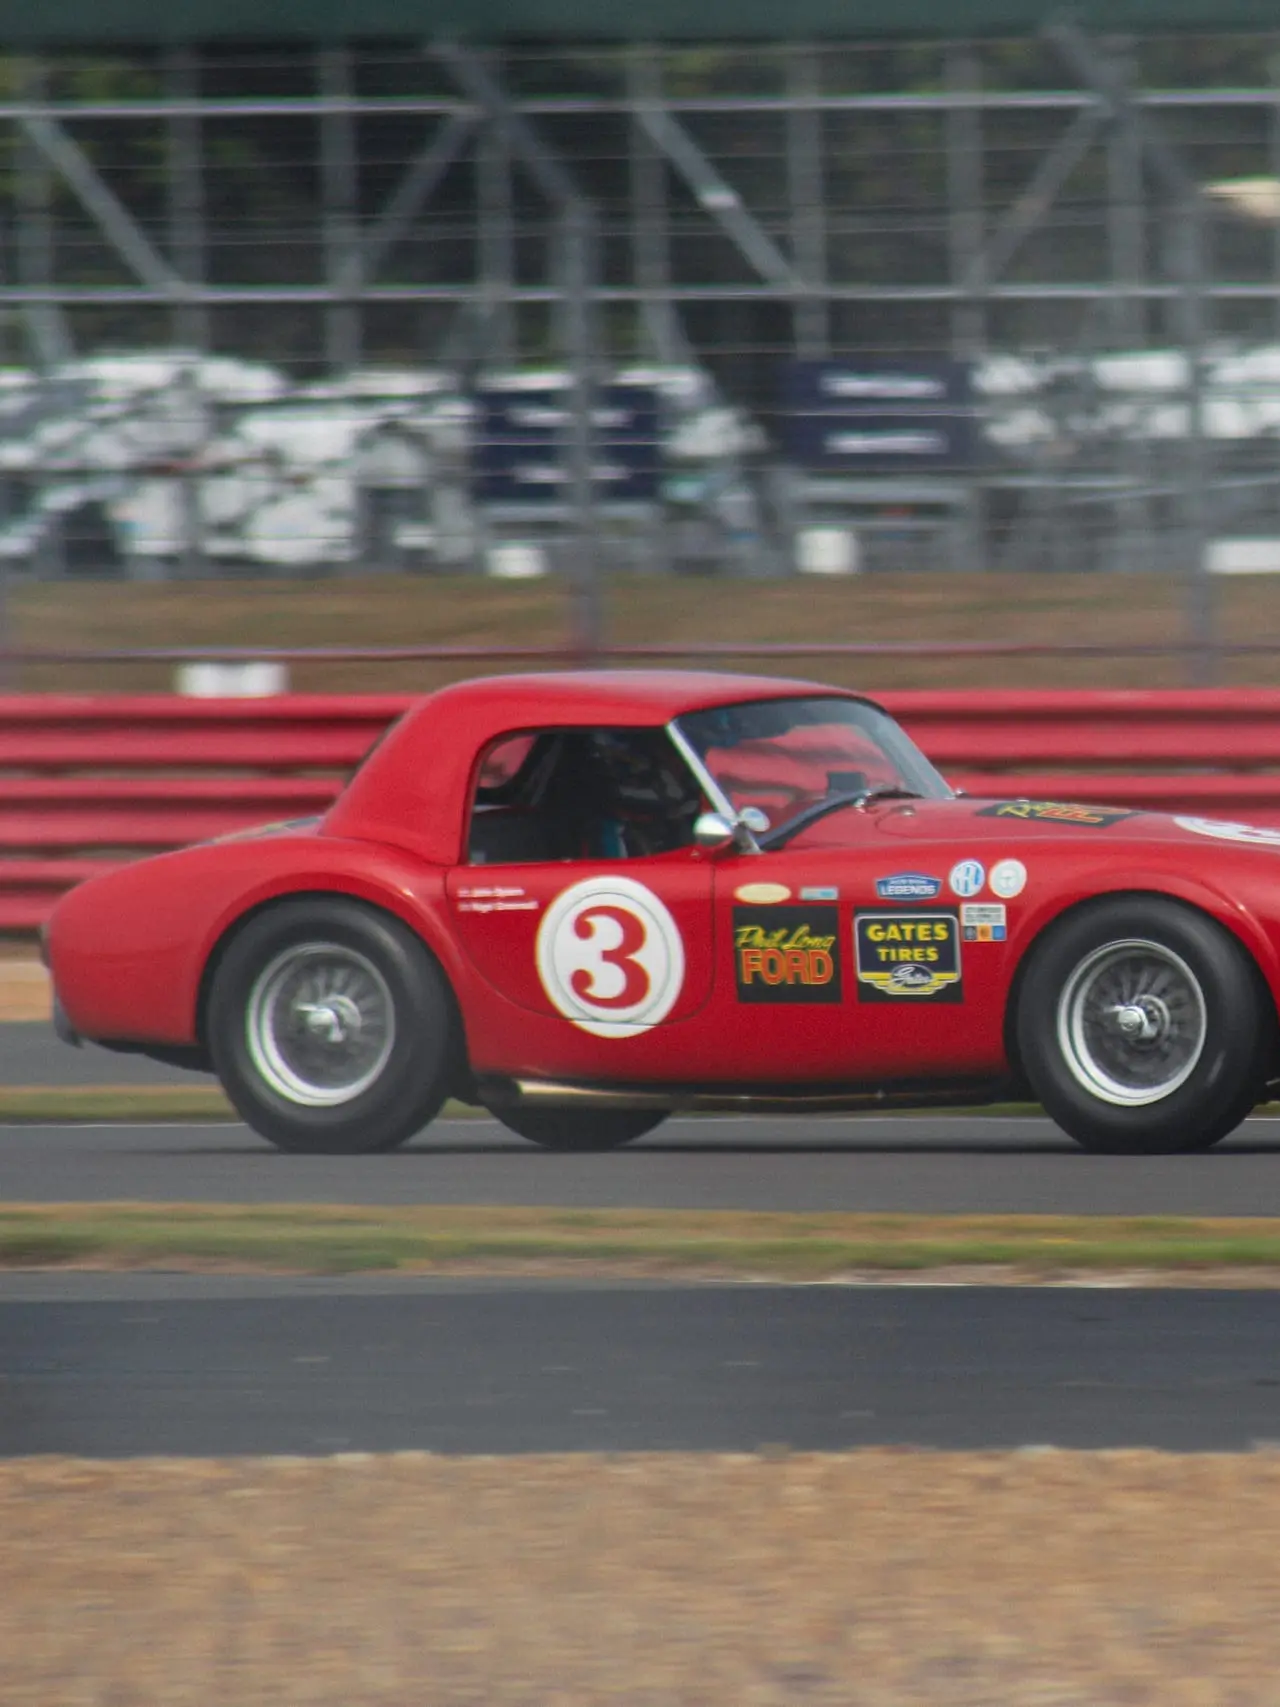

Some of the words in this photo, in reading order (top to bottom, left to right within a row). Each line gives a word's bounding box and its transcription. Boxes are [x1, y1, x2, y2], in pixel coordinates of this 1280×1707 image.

[880, 884, 936, 896] LEGENDS
[866, 922, 949, 942] GATES
[571, 905, 649, 1009] 3
[876, 946, 939, 962] TIRES
[741, 948, 833, 985] FORD
